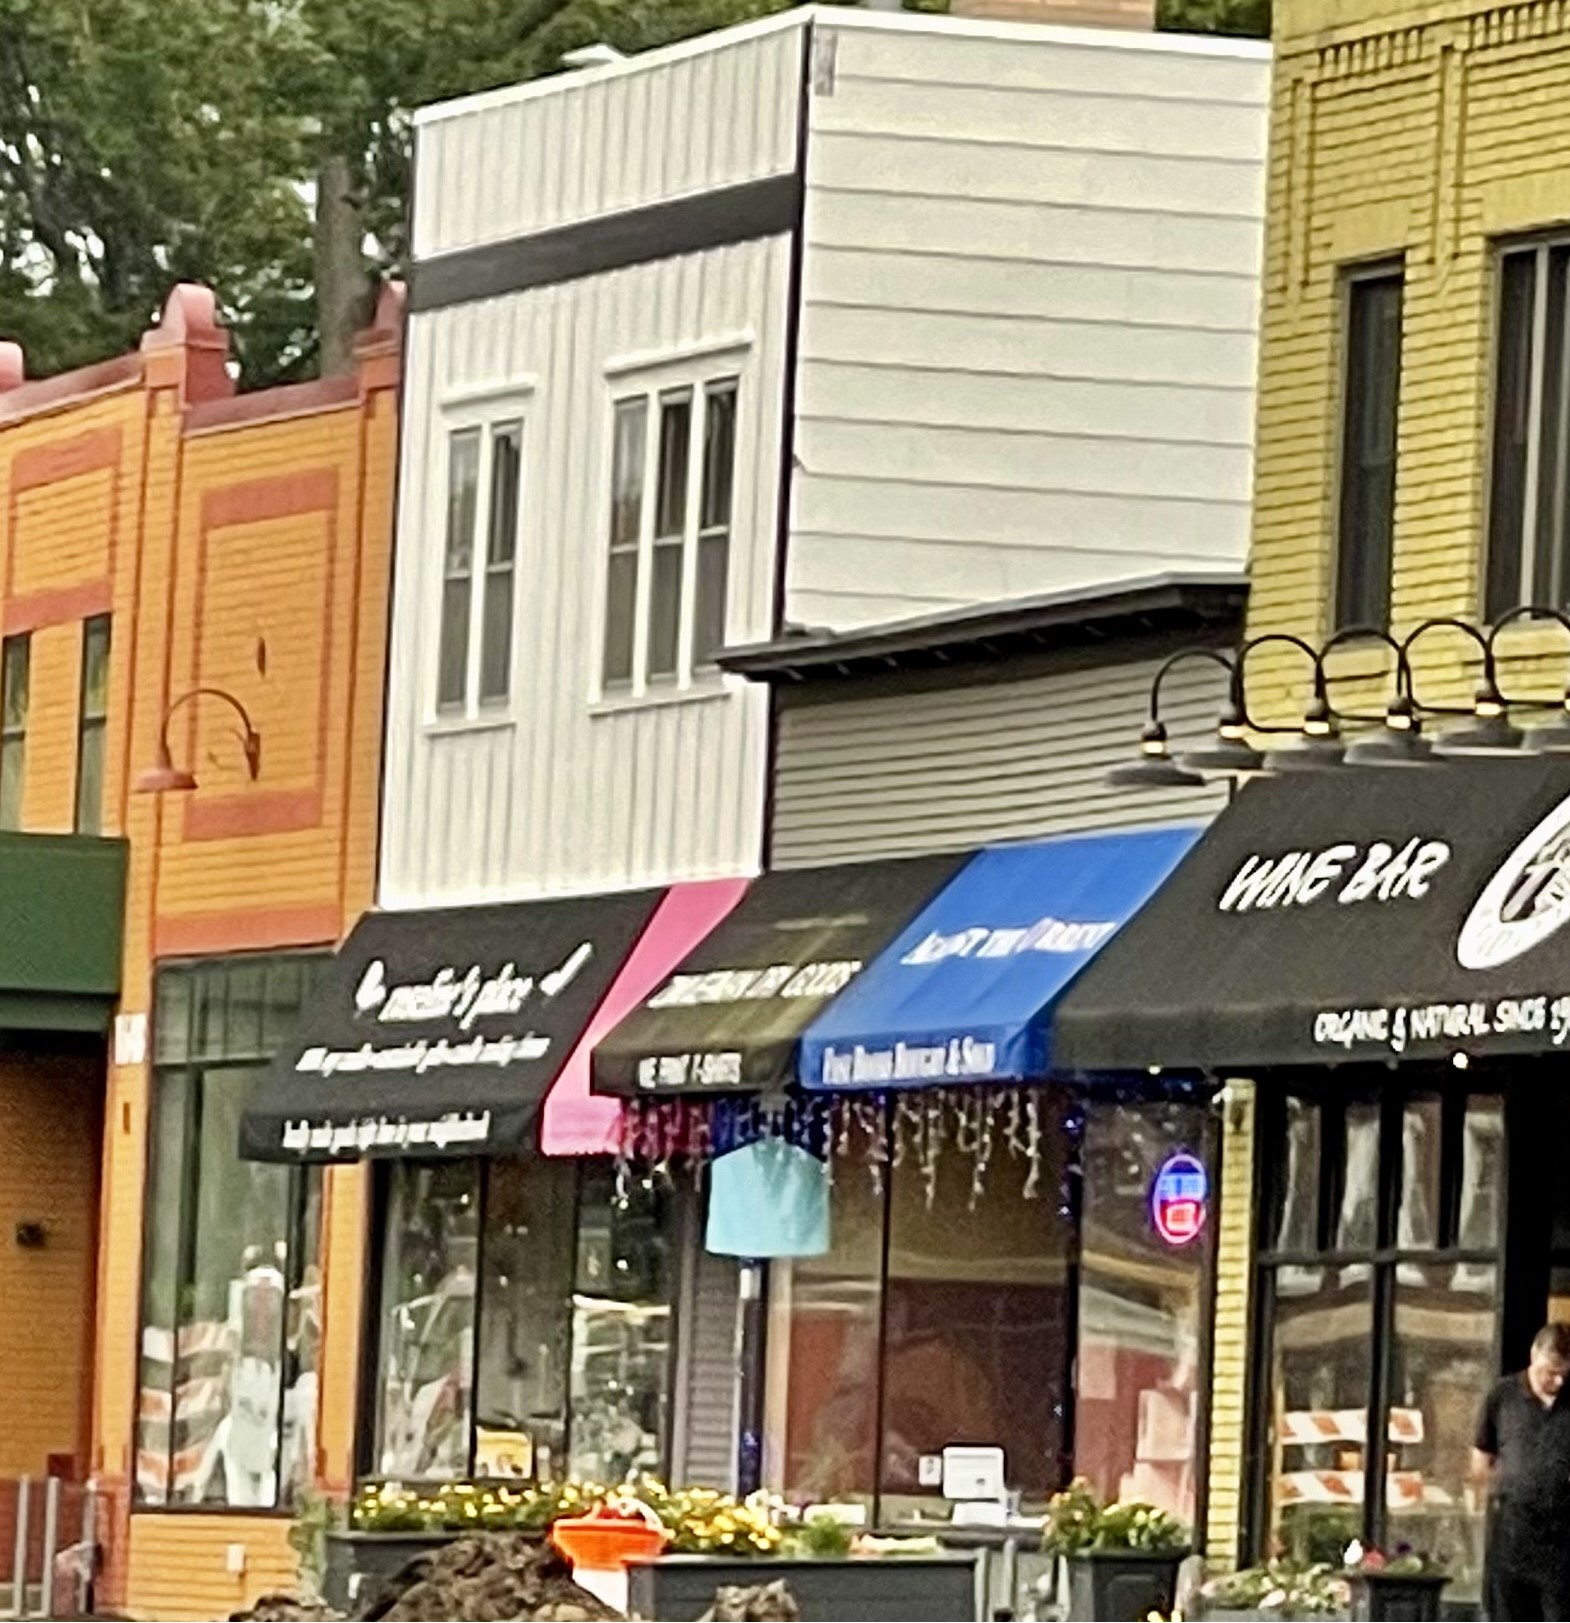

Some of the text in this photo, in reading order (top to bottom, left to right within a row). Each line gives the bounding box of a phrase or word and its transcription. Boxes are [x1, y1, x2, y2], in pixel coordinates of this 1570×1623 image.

[1219, 836, 1450, 912] WINE BAR
[1493, 996, 1548, 1033] SINCE
